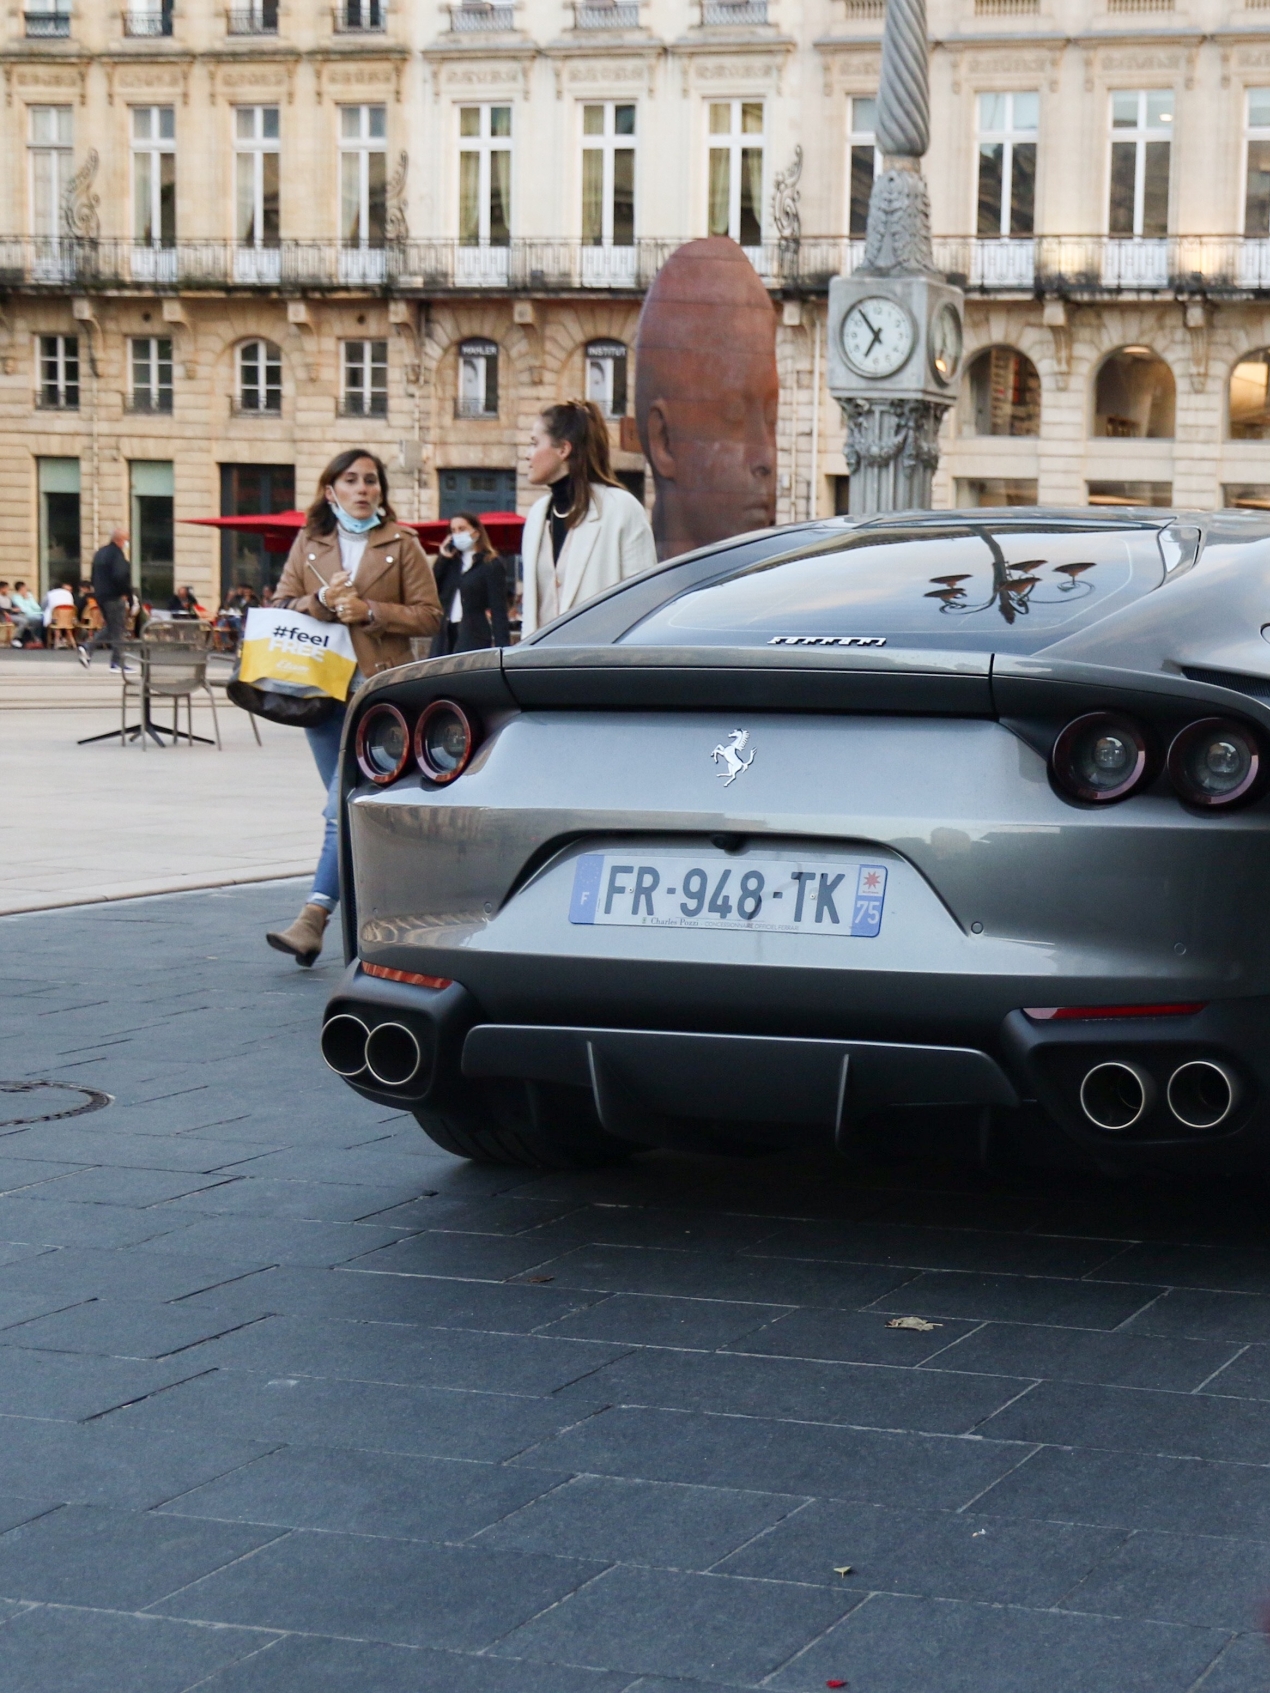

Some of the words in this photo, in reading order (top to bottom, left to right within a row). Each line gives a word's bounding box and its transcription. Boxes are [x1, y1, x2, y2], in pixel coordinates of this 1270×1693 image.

[587, 346, 626, 356] INSTITUT
[272, 625, 330, 648] #feel
[267, 637, 326, 664] FREE
[580, 891, 590, 905] F
[603, 865, 846, 925] FR-948-TK
[650, 917, 677, 926] Charles
[679, 918, 699, 927] Pozzi
[854, 900, 880, 925] 75
